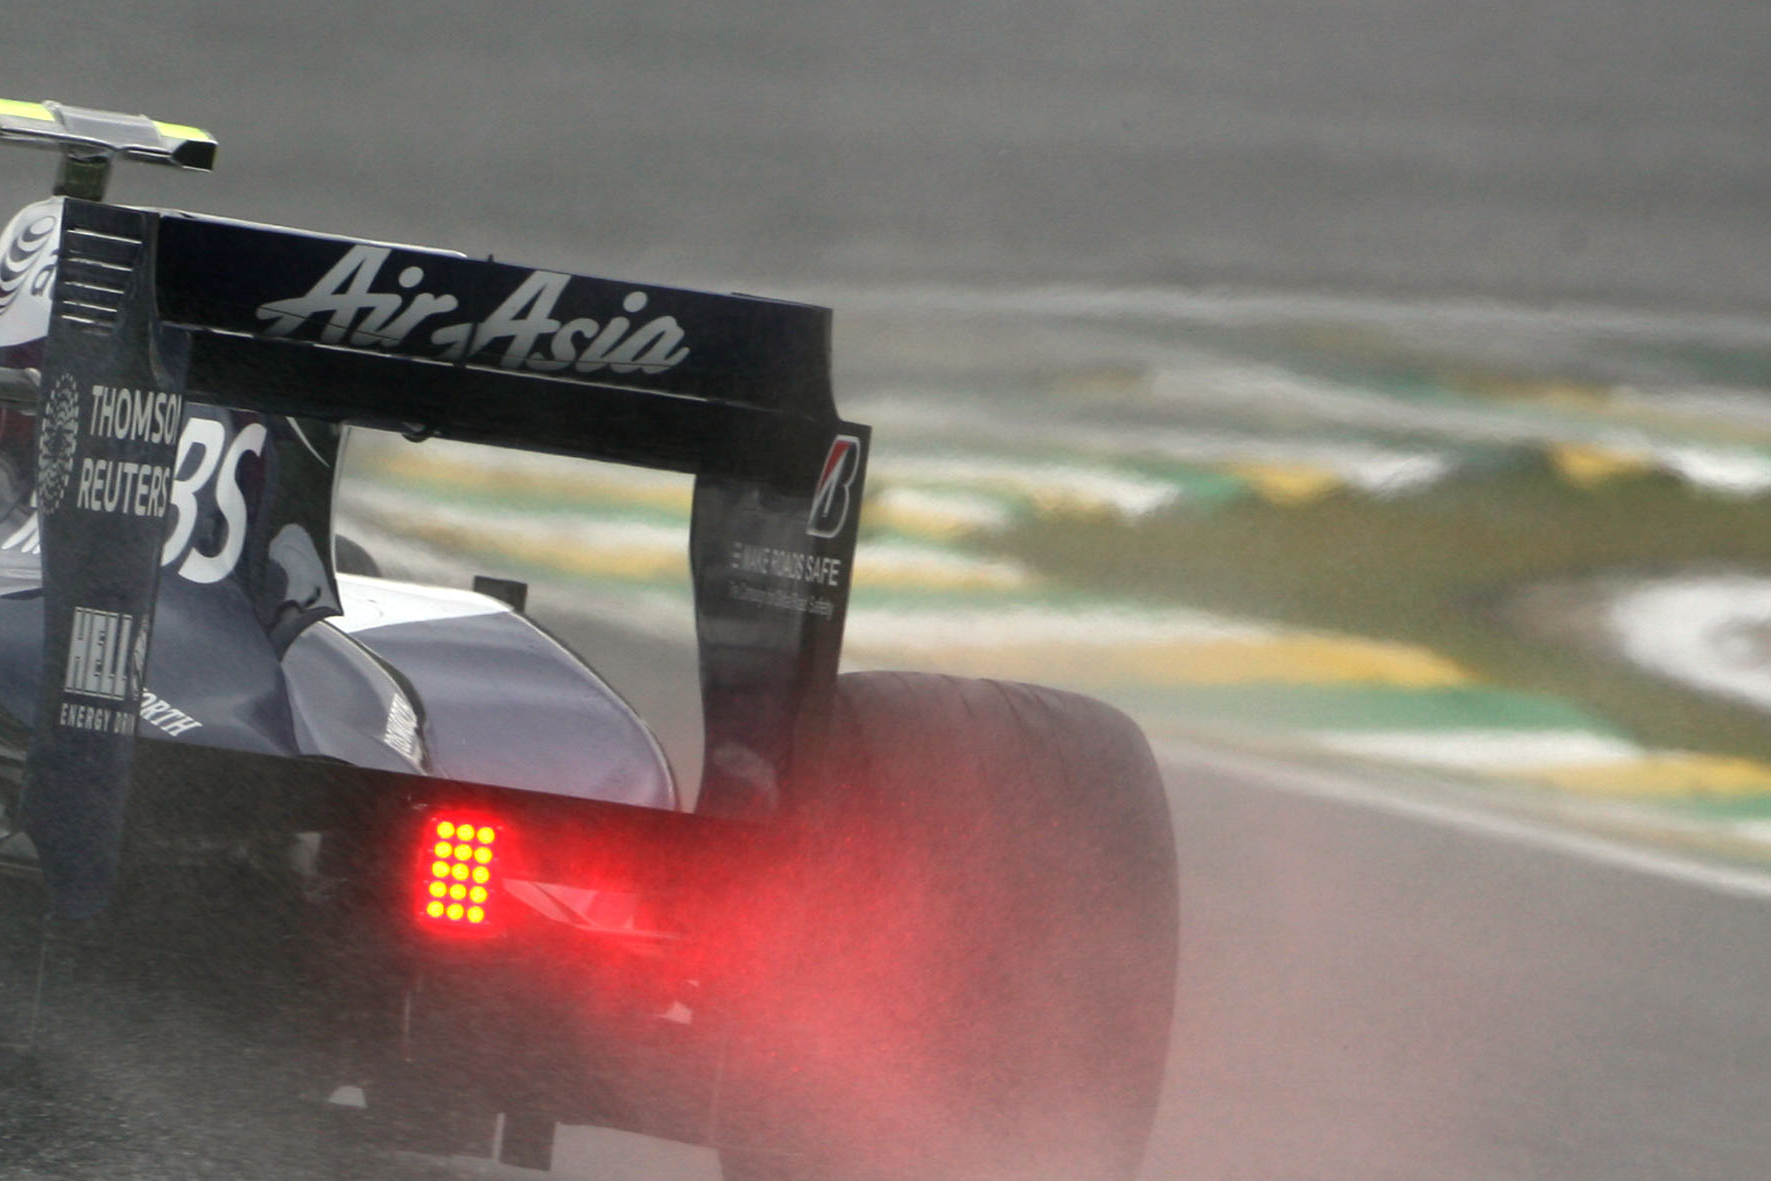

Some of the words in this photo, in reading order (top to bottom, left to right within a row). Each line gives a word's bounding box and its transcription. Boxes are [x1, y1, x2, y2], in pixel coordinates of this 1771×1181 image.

[77, 457, 171, 518] REUTERS
[161, 417, 267, 584] BS
[805, 555, 841, 586] SAFE
[64, 607, 132, 700] HELL
[60, 703, 111, 732] ENERGY
[140, 687, 203, 737] ORTH
